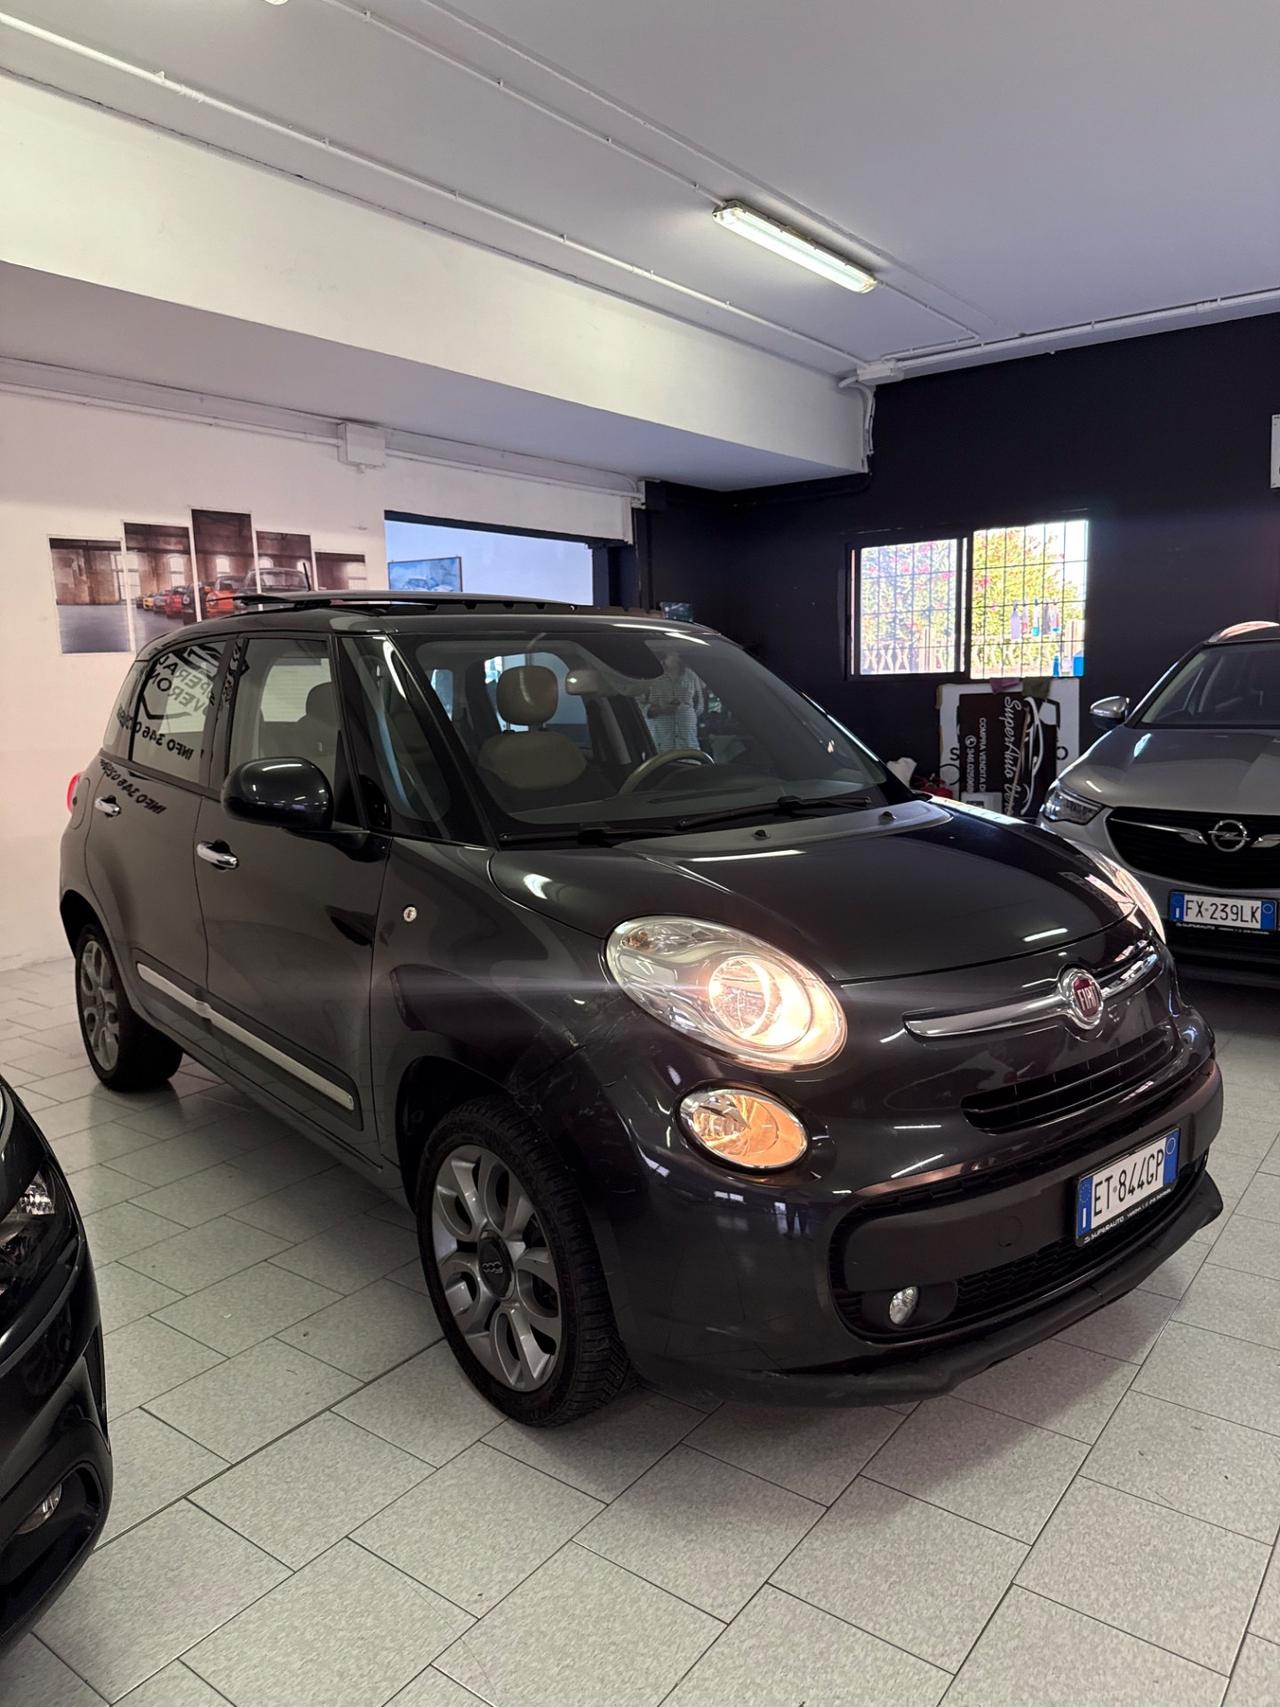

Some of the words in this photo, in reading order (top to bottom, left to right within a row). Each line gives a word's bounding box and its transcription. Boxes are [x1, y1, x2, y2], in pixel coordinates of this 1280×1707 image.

[979, 717, 987, 751] COMPRA
[1000, 696, 1022, 778] SuperAuto
[979, 751, 987, 783] VENDITA
[1076, 985, 1099, 1011] FIAT
